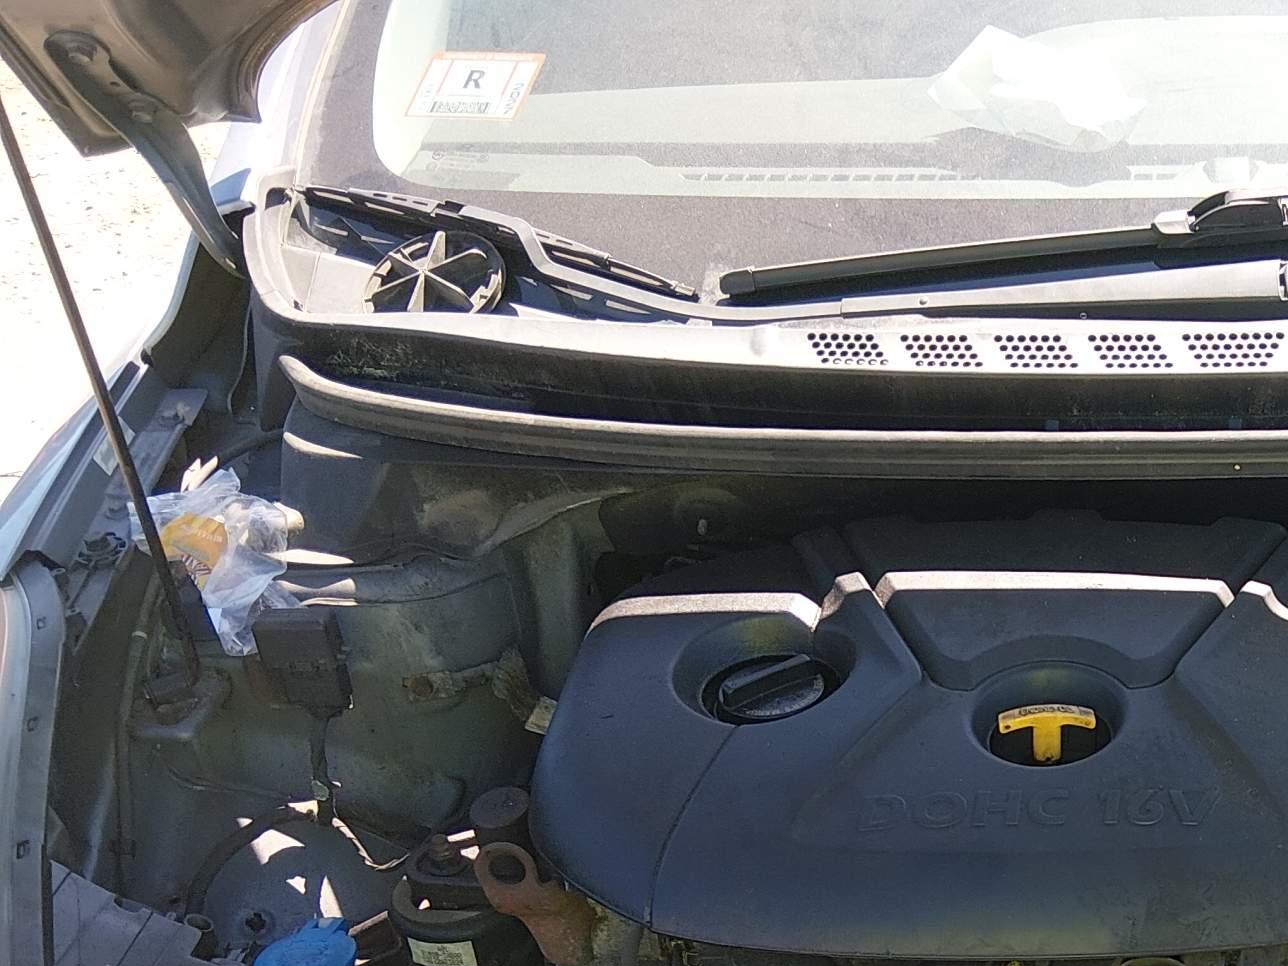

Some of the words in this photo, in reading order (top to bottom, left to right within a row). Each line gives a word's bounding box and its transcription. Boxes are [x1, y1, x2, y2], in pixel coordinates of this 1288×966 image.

[462, 69, 486, 90] R
[857, 789, 1071, 832] DOHC
[1098, 785, 1222, 827] 16V
